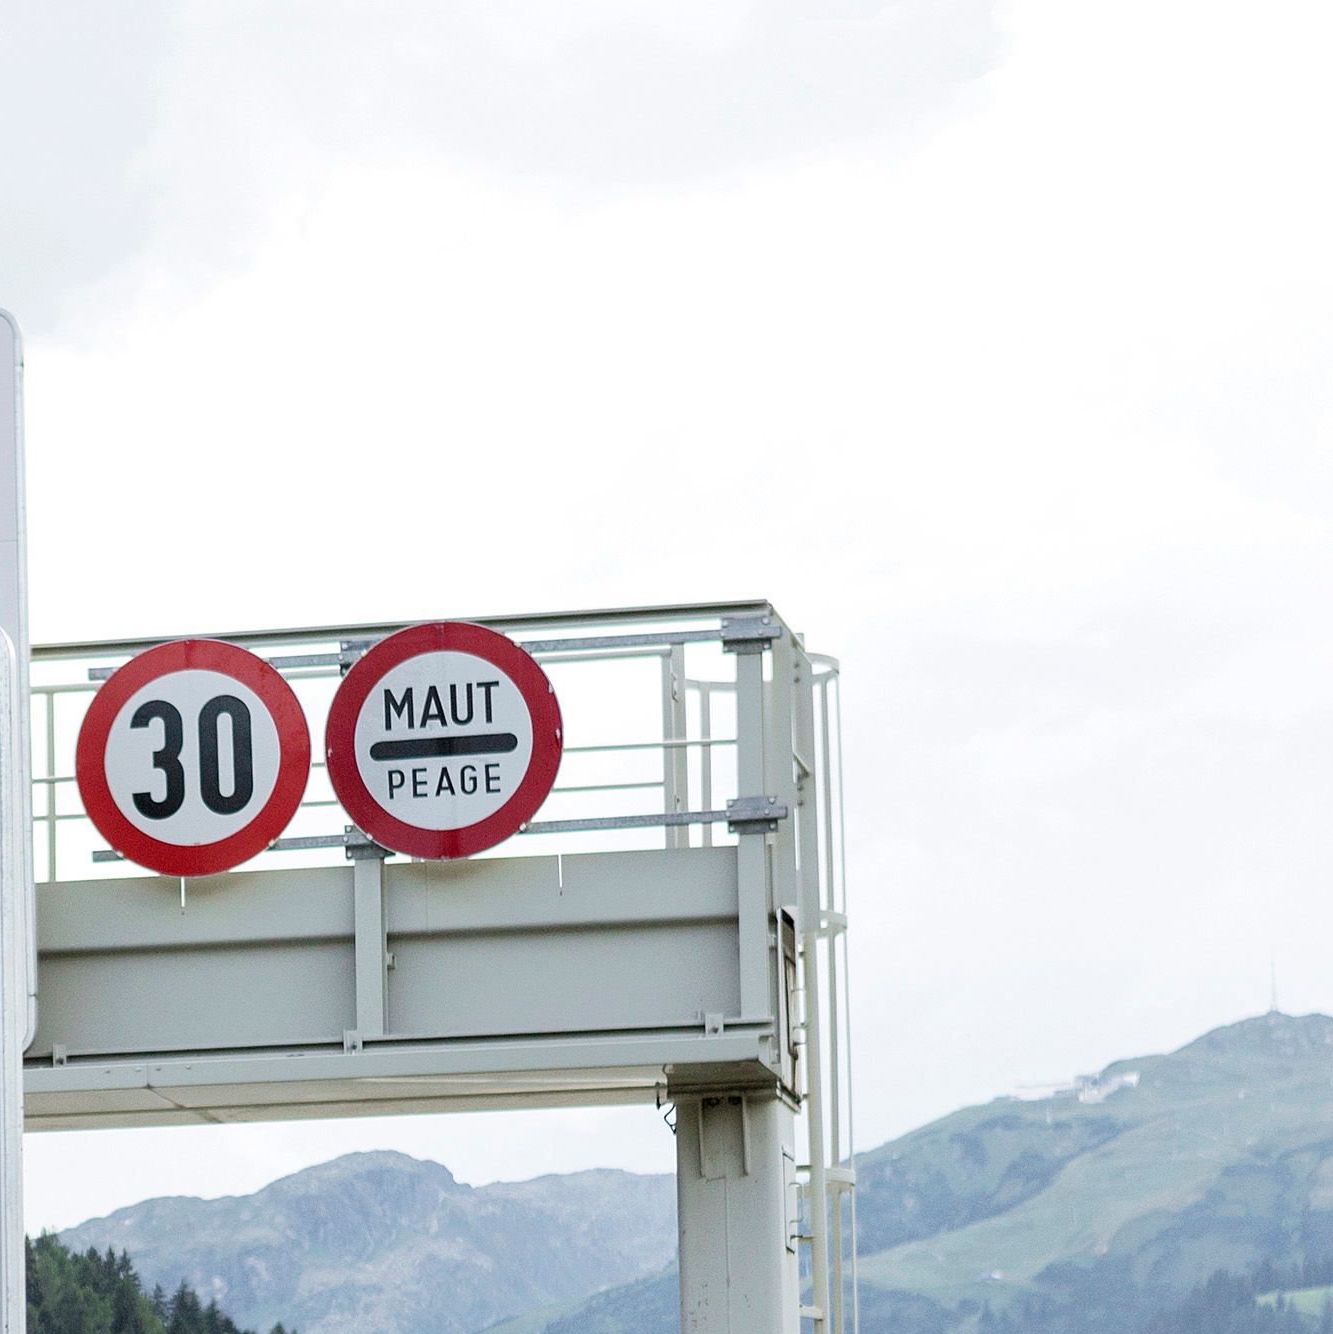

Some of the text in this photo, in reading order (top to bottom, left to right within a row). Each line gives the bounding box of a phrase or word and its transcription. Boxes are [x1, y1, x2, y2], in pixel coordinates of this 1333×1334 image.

[383, 680, 500, 731] MAUT
[130, 694, 255, 820] 30
[387, 763, 501, 800] PEAGE
